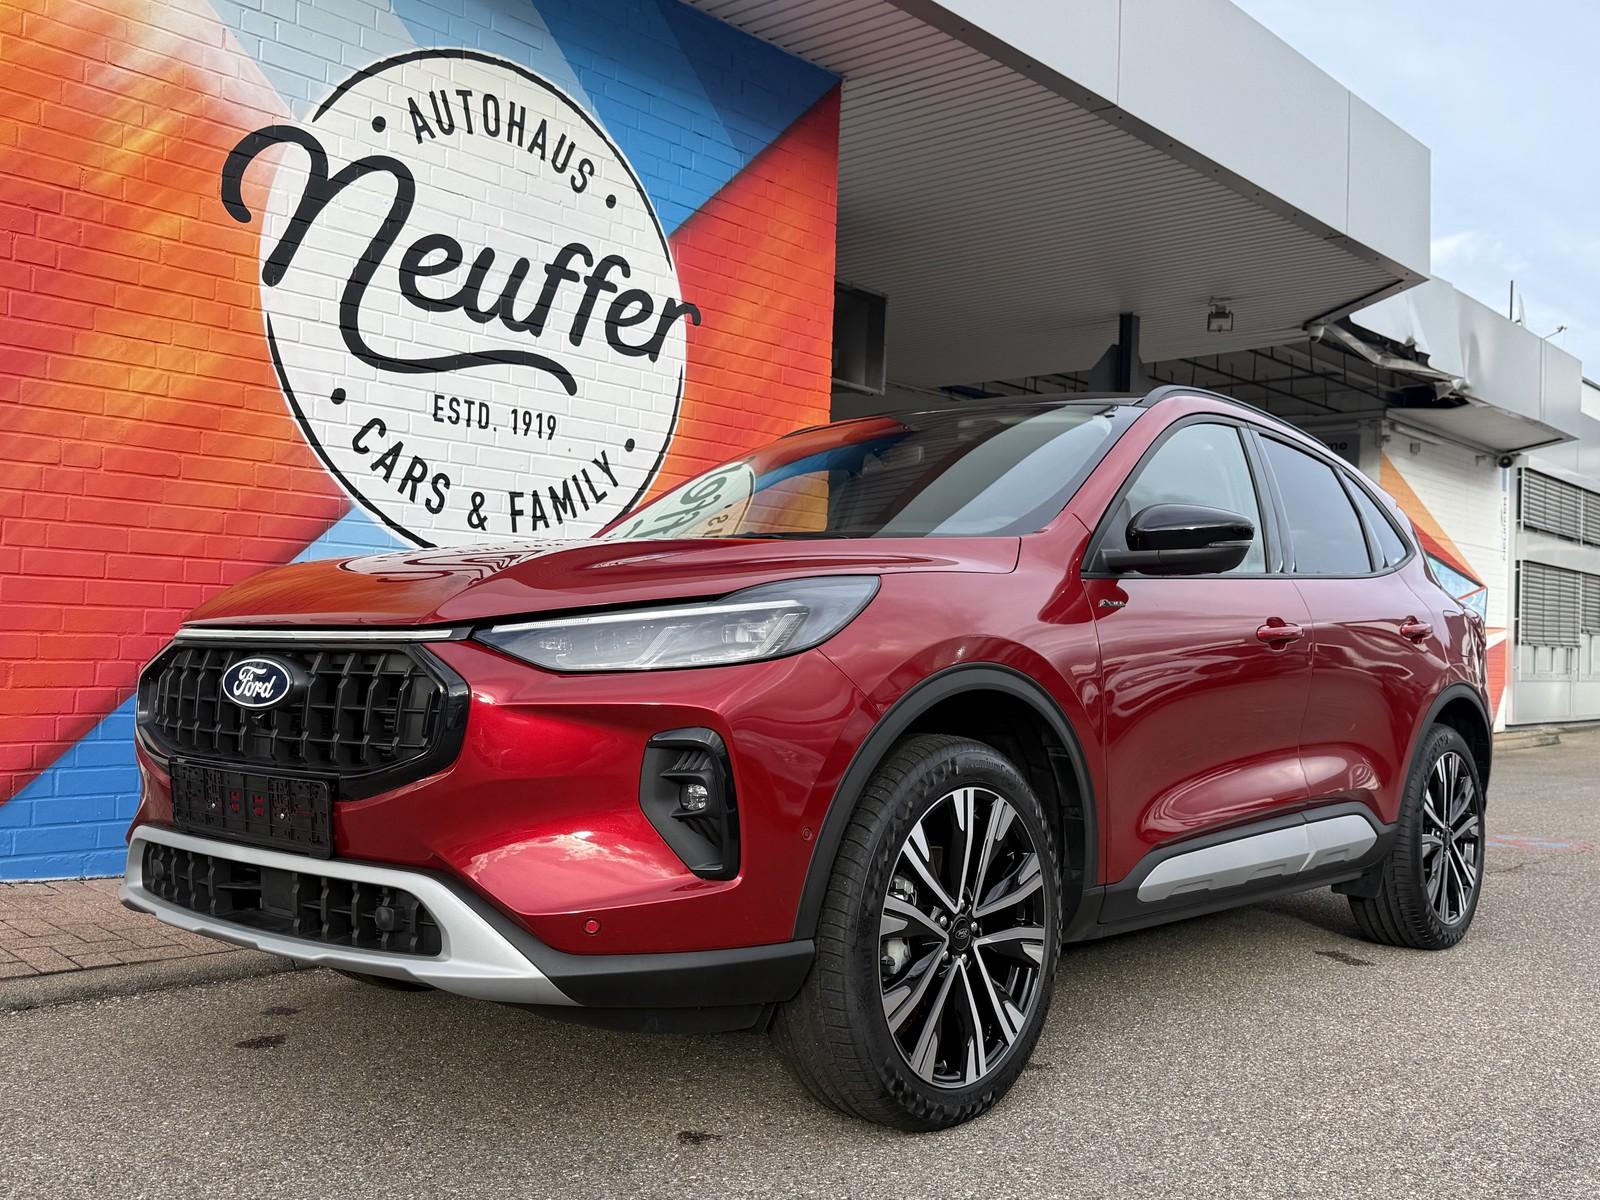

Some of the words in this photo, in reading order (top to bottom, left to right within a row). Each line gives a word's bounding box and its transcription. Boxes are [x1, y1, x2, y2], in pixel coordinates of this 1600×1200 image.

[408, 89, 596, 194] AUTOHAUS
[433, 394, 497, 432] ESTD.
[511, 408, 557, 441] 1919
[352, 417, 451, 515] CARS
[467, 491, 488, 531] &
[508, 450, 619, 533] FAMILY
[233, 665, 277, 699] Ford
